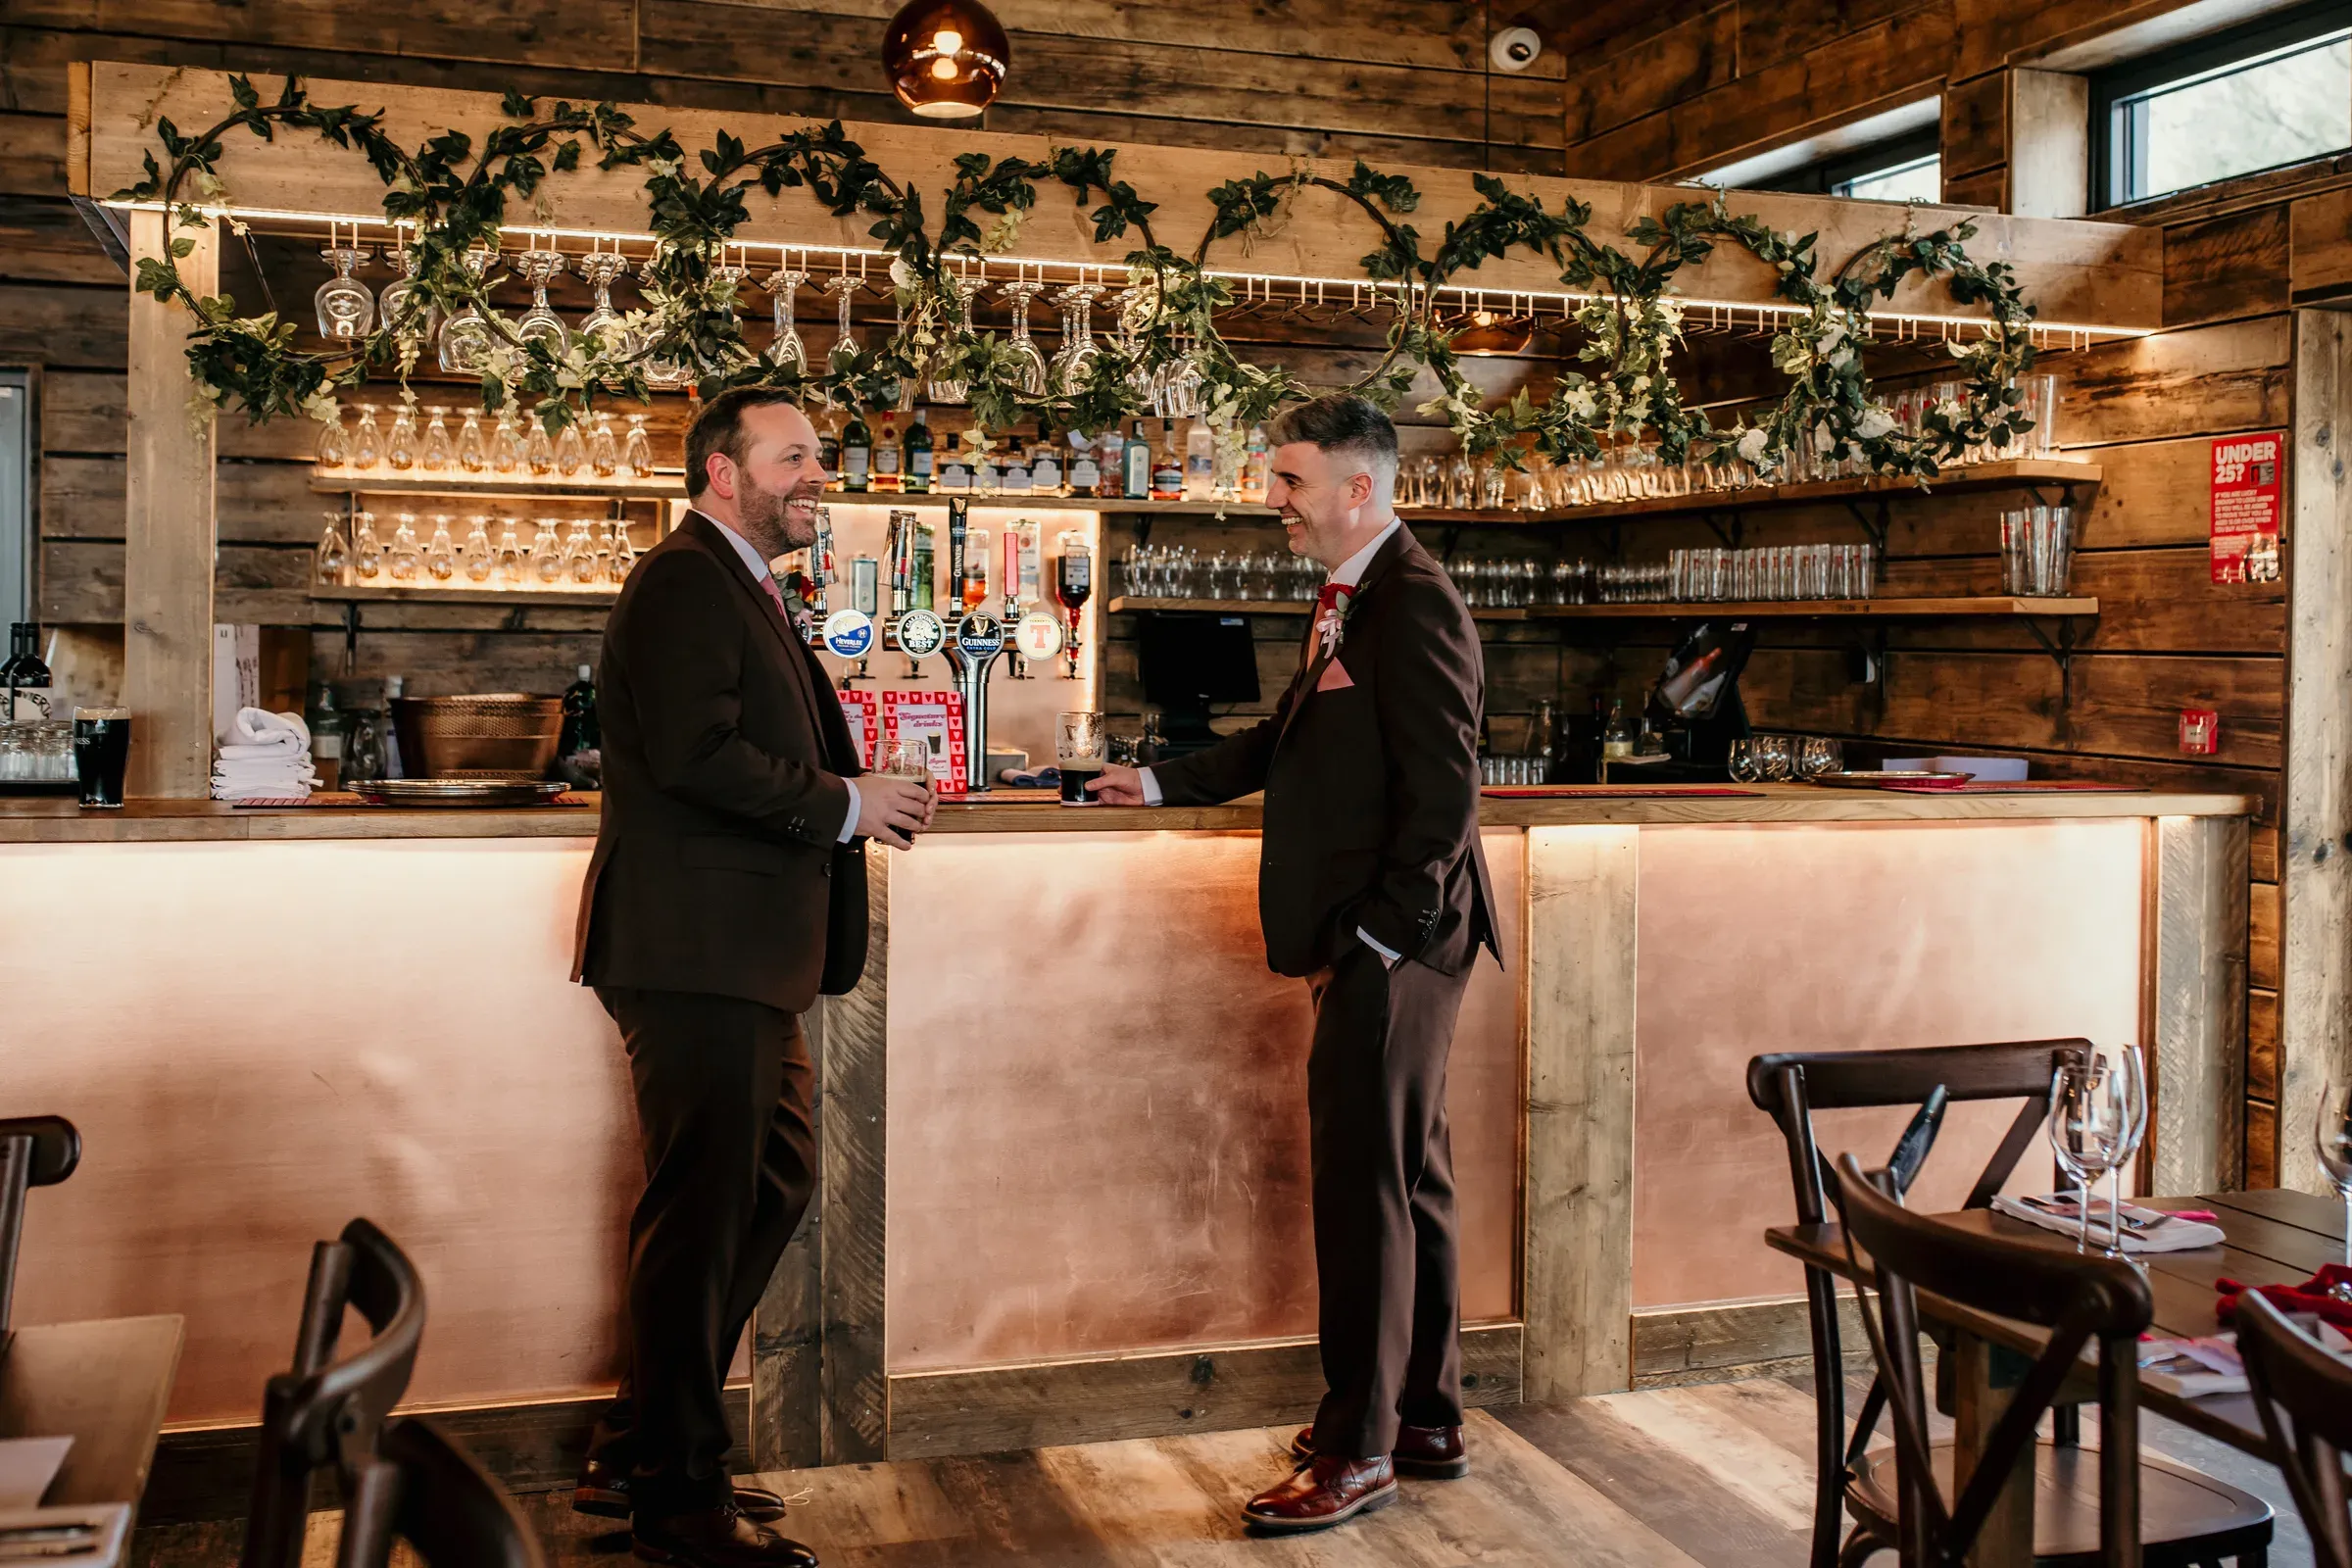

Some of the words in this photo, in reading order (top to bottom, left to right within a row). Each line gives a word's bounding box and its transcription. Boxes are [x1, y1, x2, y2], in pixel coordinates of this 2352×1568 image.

[2216, 441, 2277, 466] UNDER
[2215, 463, 2245, 484] 25?
[954, 544, 962, 577] GUINNESS
[835, 637, 862, 646] HEVERLEE
[908, 639, 934, 648] BEST
[961, 637, 1001, 647] GUINNESS
[1029, 625, 1051, 649] T
[899, 711, 946, 722] Signature
